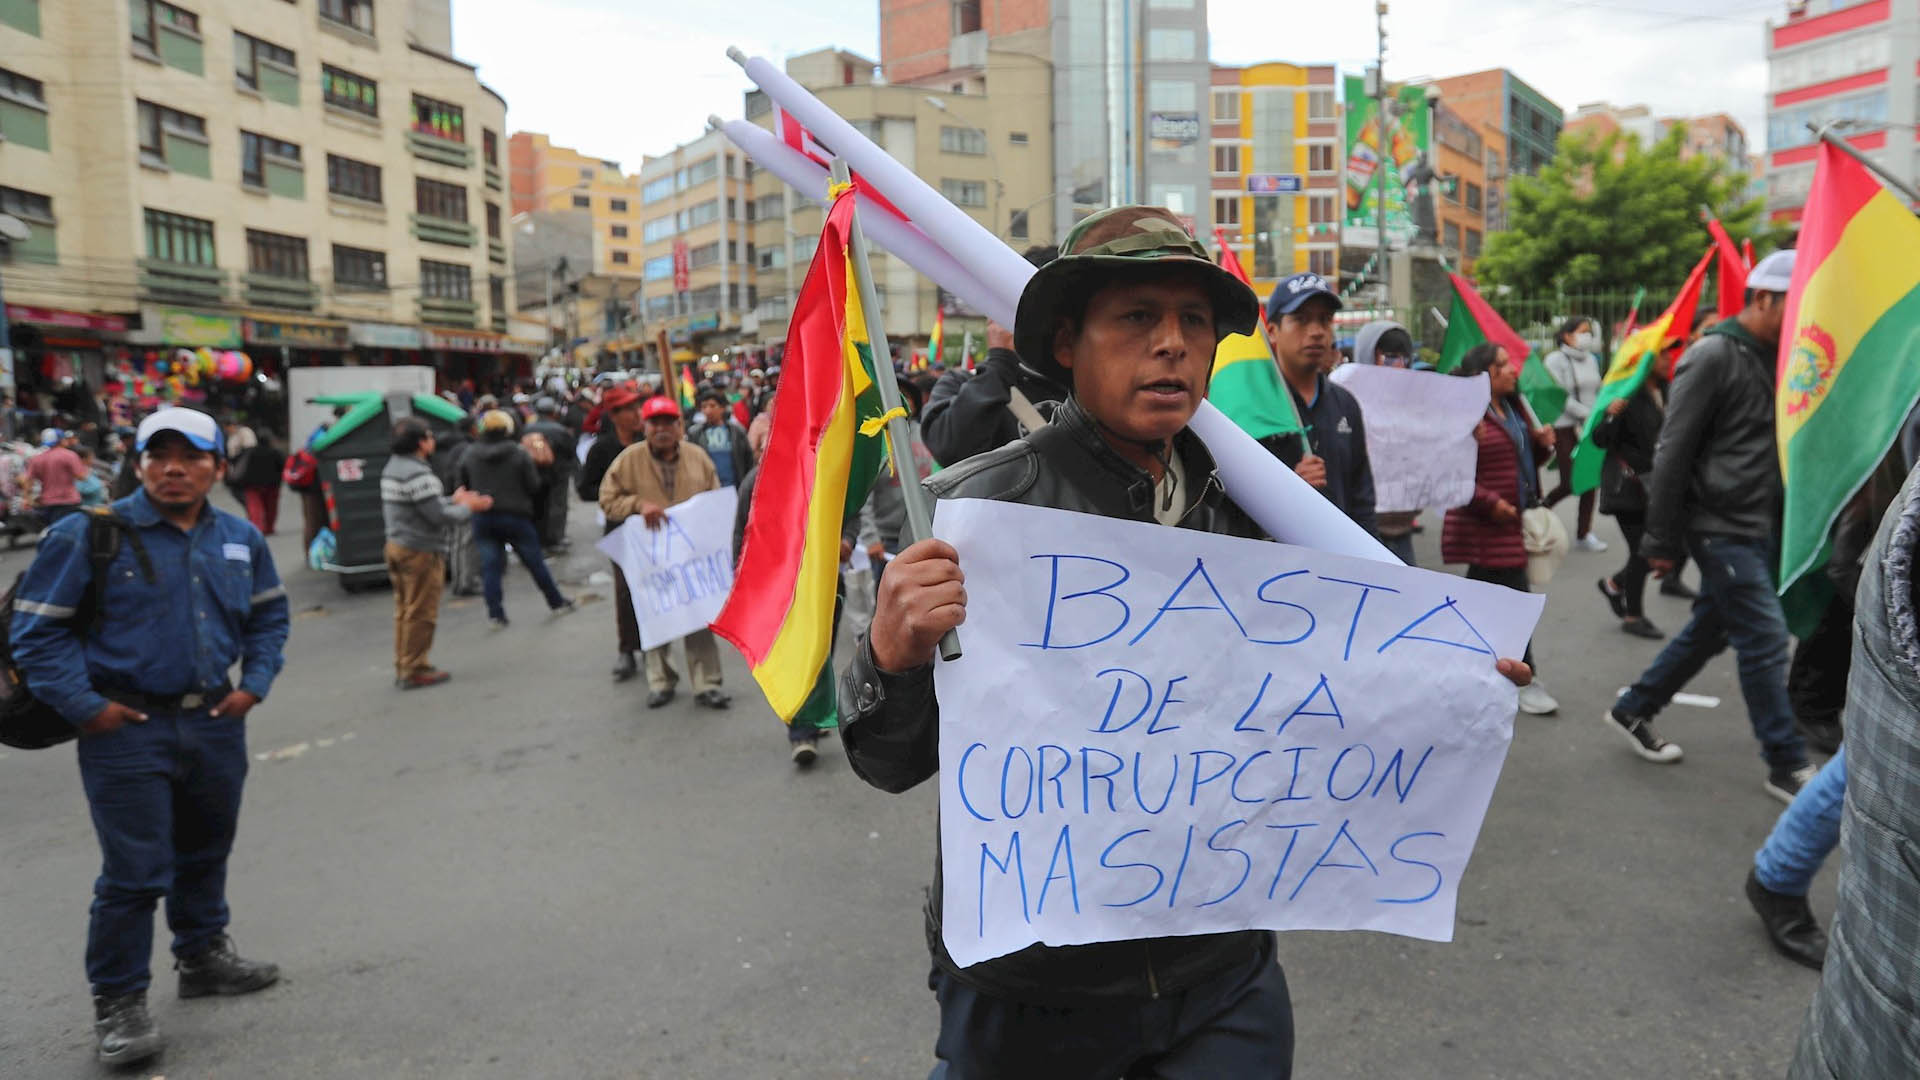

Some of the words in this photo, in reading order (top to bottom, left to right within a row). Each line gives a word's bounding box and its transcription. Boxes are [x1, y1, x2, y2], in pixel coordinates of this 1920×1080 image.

[1019, 554, 1498, 662] BASTA
[1089, 667, 1188, 736] DE
[1233, 671, 1345, 736] LA
[957, 742, 1434, 822] CORRUPCION
[979, 817, 1446, 938] MASISTAS
